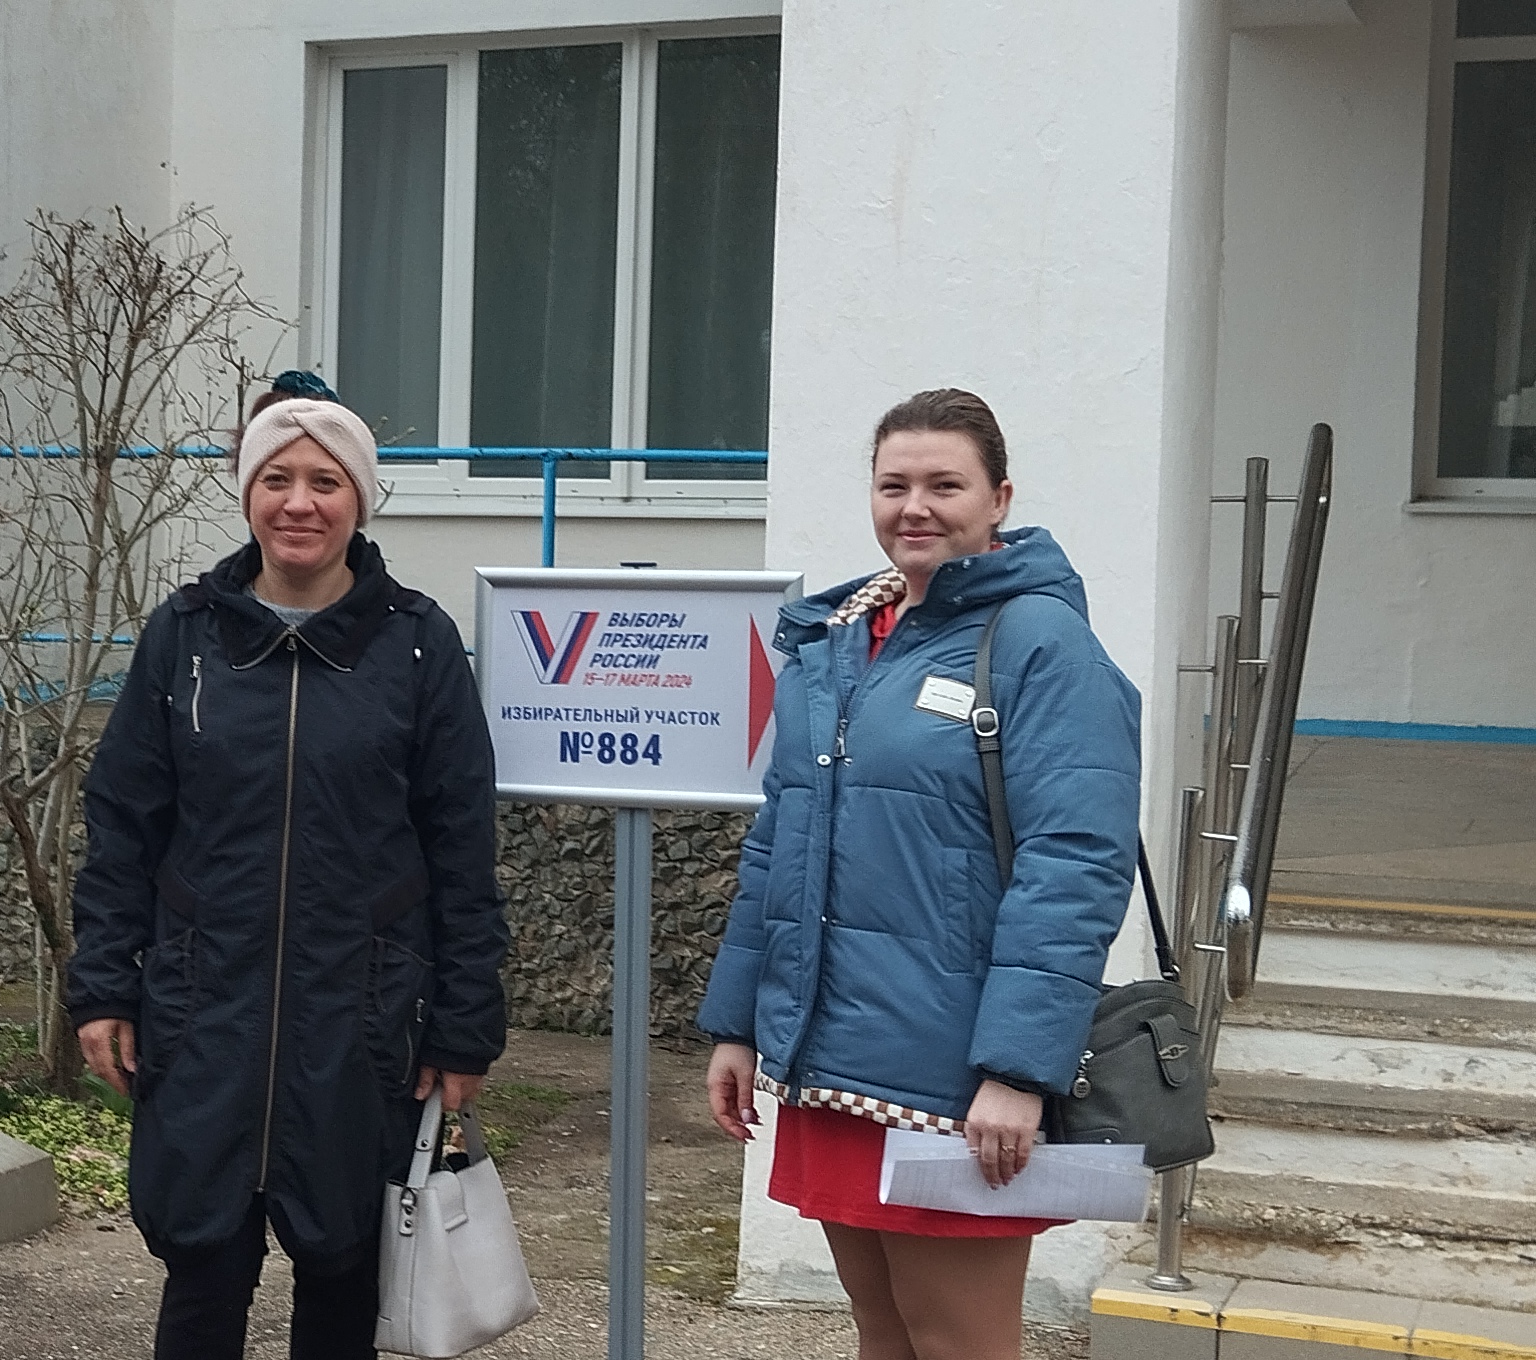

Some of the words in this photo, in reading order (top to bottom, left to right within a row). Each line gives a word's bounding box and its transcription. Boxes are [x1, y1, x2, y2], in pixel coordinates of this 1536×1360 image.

[607, 612, 687, 628] ВЫБОРЫ
[597, 632, 709, 651] ПРЕЗИДЕНТА
[589, 653, 661, 669] РОССИИ
[617, 673, 661, 687] МАРТА
[661, 674, 693, 688] 2024
[501, 704, 641, 724] ИЗБИРАТЕЛЬНЫЙ
[644, 709, 721, 727] УЧАСТОК
[559, 730, 663, 766] №884
